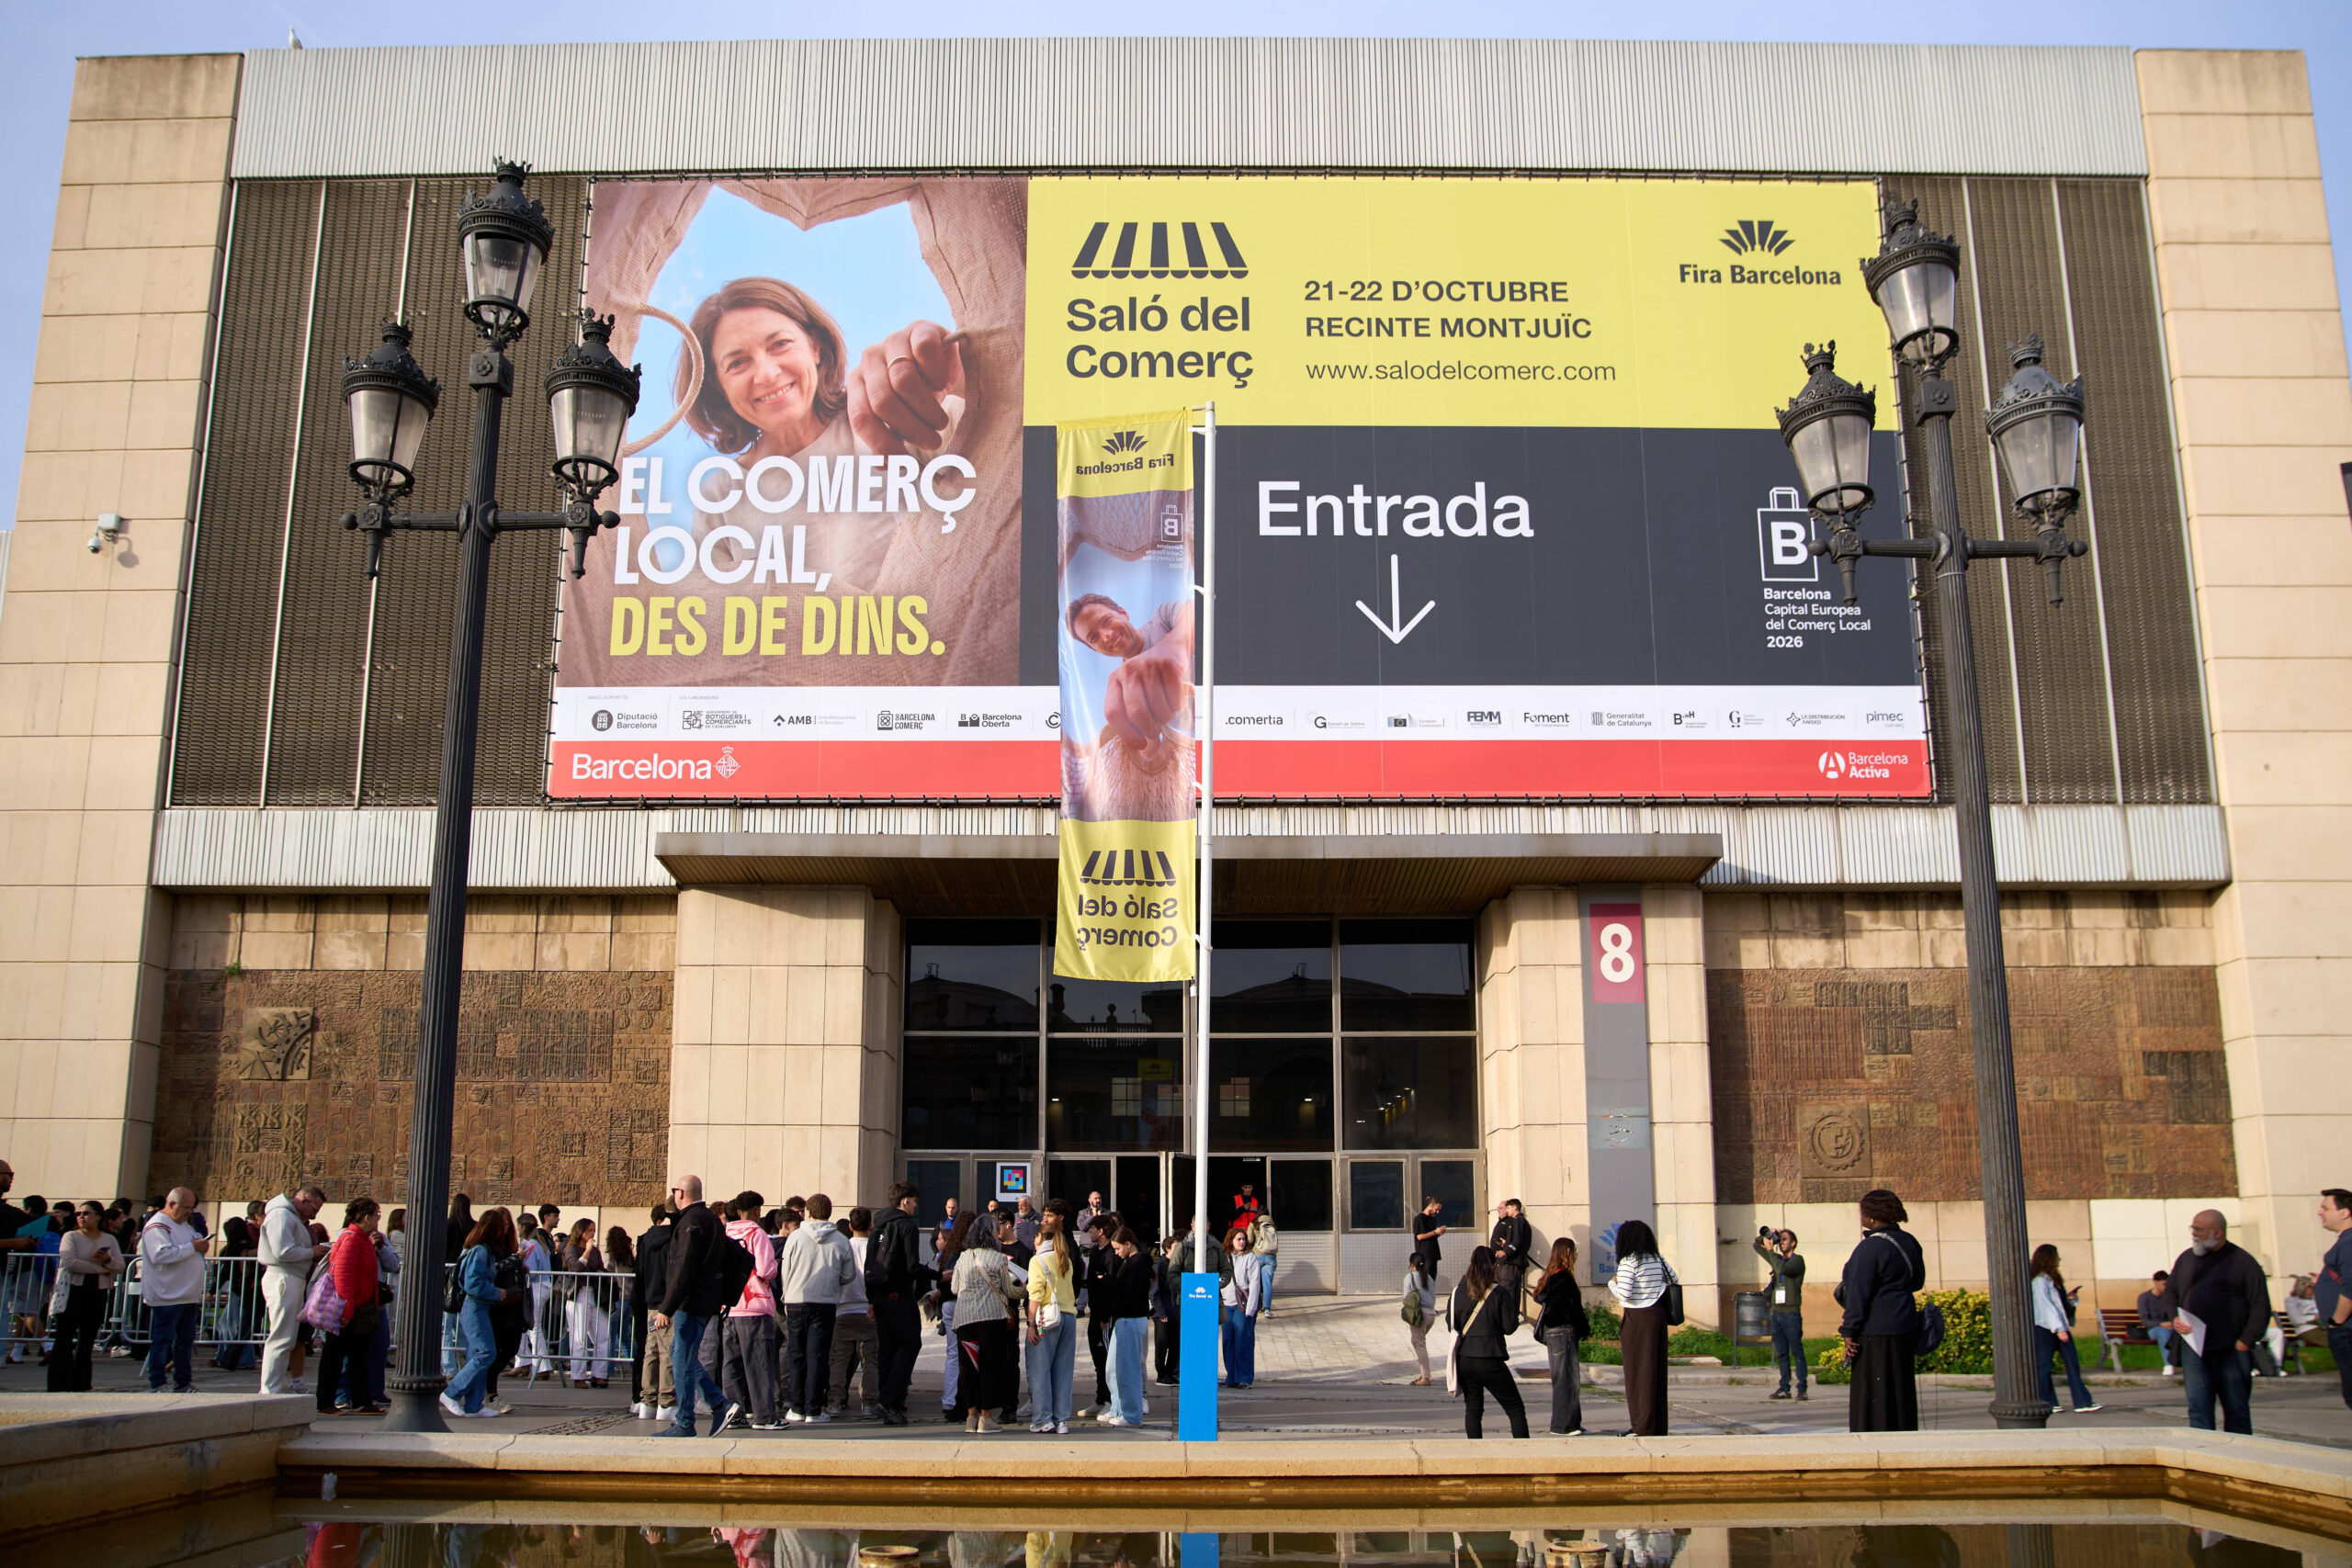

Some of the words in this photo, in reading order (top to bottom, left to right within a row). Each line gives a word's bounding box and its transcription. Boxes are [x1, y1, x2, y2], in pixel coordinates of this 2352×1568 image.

[1679, 265, 1722, 283] Fira
[1730, 265, 1840, 285] Barcelona
[1305, 281, 1383, 300] 21-22
[1393, 281, 1568, 301] D’OCTUBRE
[1067, 294, 1168, 332] Saló
[1181, 297, 1250, 332] del
[1306, 317, 1430, 337] RECINTE
[1441, 313, 1591, 338] MONTJUÏC
[1067, 344, 1253, 389] Comerç
[1306, 360, 1615, 380] www.salodelcomerc.com
[619, 457, 672, 515] EL
[687, 454, 977, 534] COMERÇ
[1259, 481, 1534, 537] Entrada
[1770, 522, 1808, 565] B
[614, 524, 832, 592] LOCAL,
[1764, 588, 1831, 600] Barcelona
[1765, 604, 1808, 617] Capital
[1812, 604, 1860, 617] Europea
[609, 595, 707, 656] DES
[722, 595, 786, 656] DE
[801, 594, 946, 656] DINS.
[1766, 619, 1784, 629] del
[1788, 619, 1836, 633] Comerç
[1839, 619, 1871, 630] Local
[1767, 636, 1803, 648] 2026
[788, 716, 811, 724] AMB
[1225, 715, 1283, 726] .comertia
[1524, 713, 1569, 723] Foment
[1867, 711, 1903, 723] pimec
[572, 753, 711, 779] Barcelona
[1849, 752, 1908, 764] Barcelona
[1849, 765, 1889, 778] Activa
[1600, 923, 1634, 983] 8
